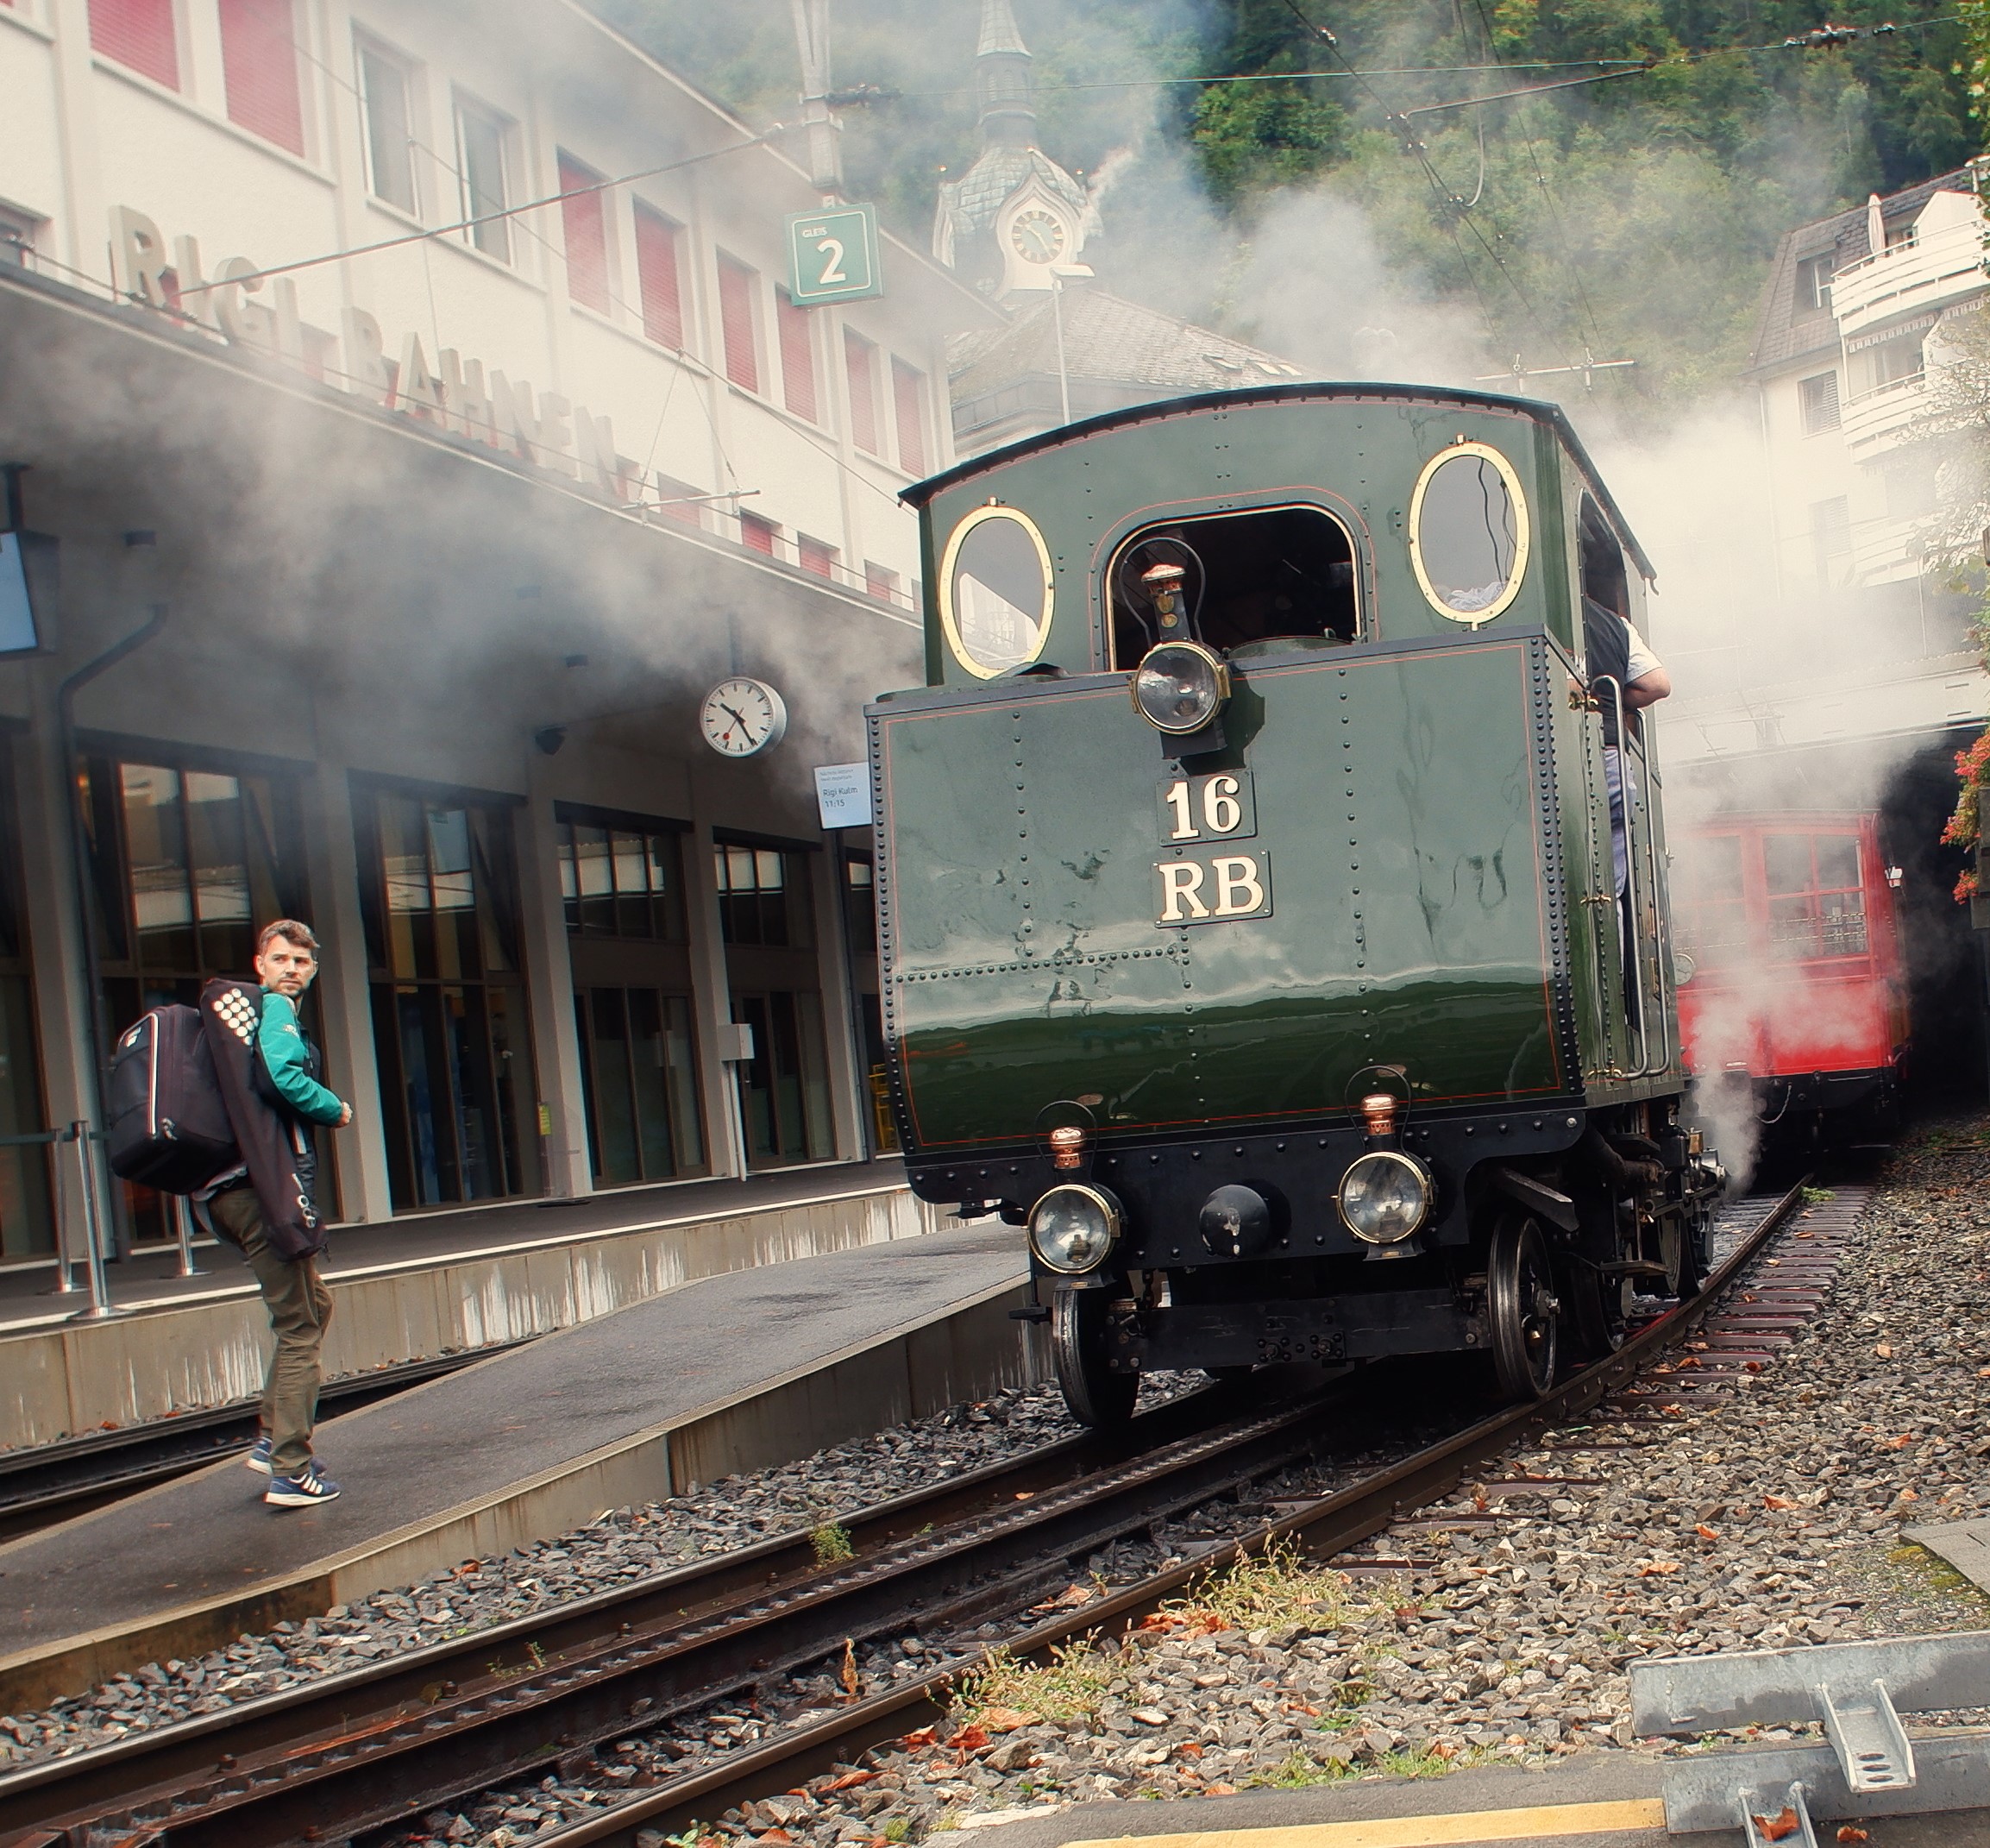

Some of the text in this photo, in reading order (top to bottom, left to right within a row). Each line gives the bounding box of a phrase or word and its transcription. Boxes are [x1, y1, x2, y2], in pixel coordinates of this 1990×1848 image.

[817, 239, 846, 285] 2
[108, 204, 625, 496] RIGI BAHNEN
[1166, 776, 1242, 839] 16
[1158, 856, 1265, 921] RB
